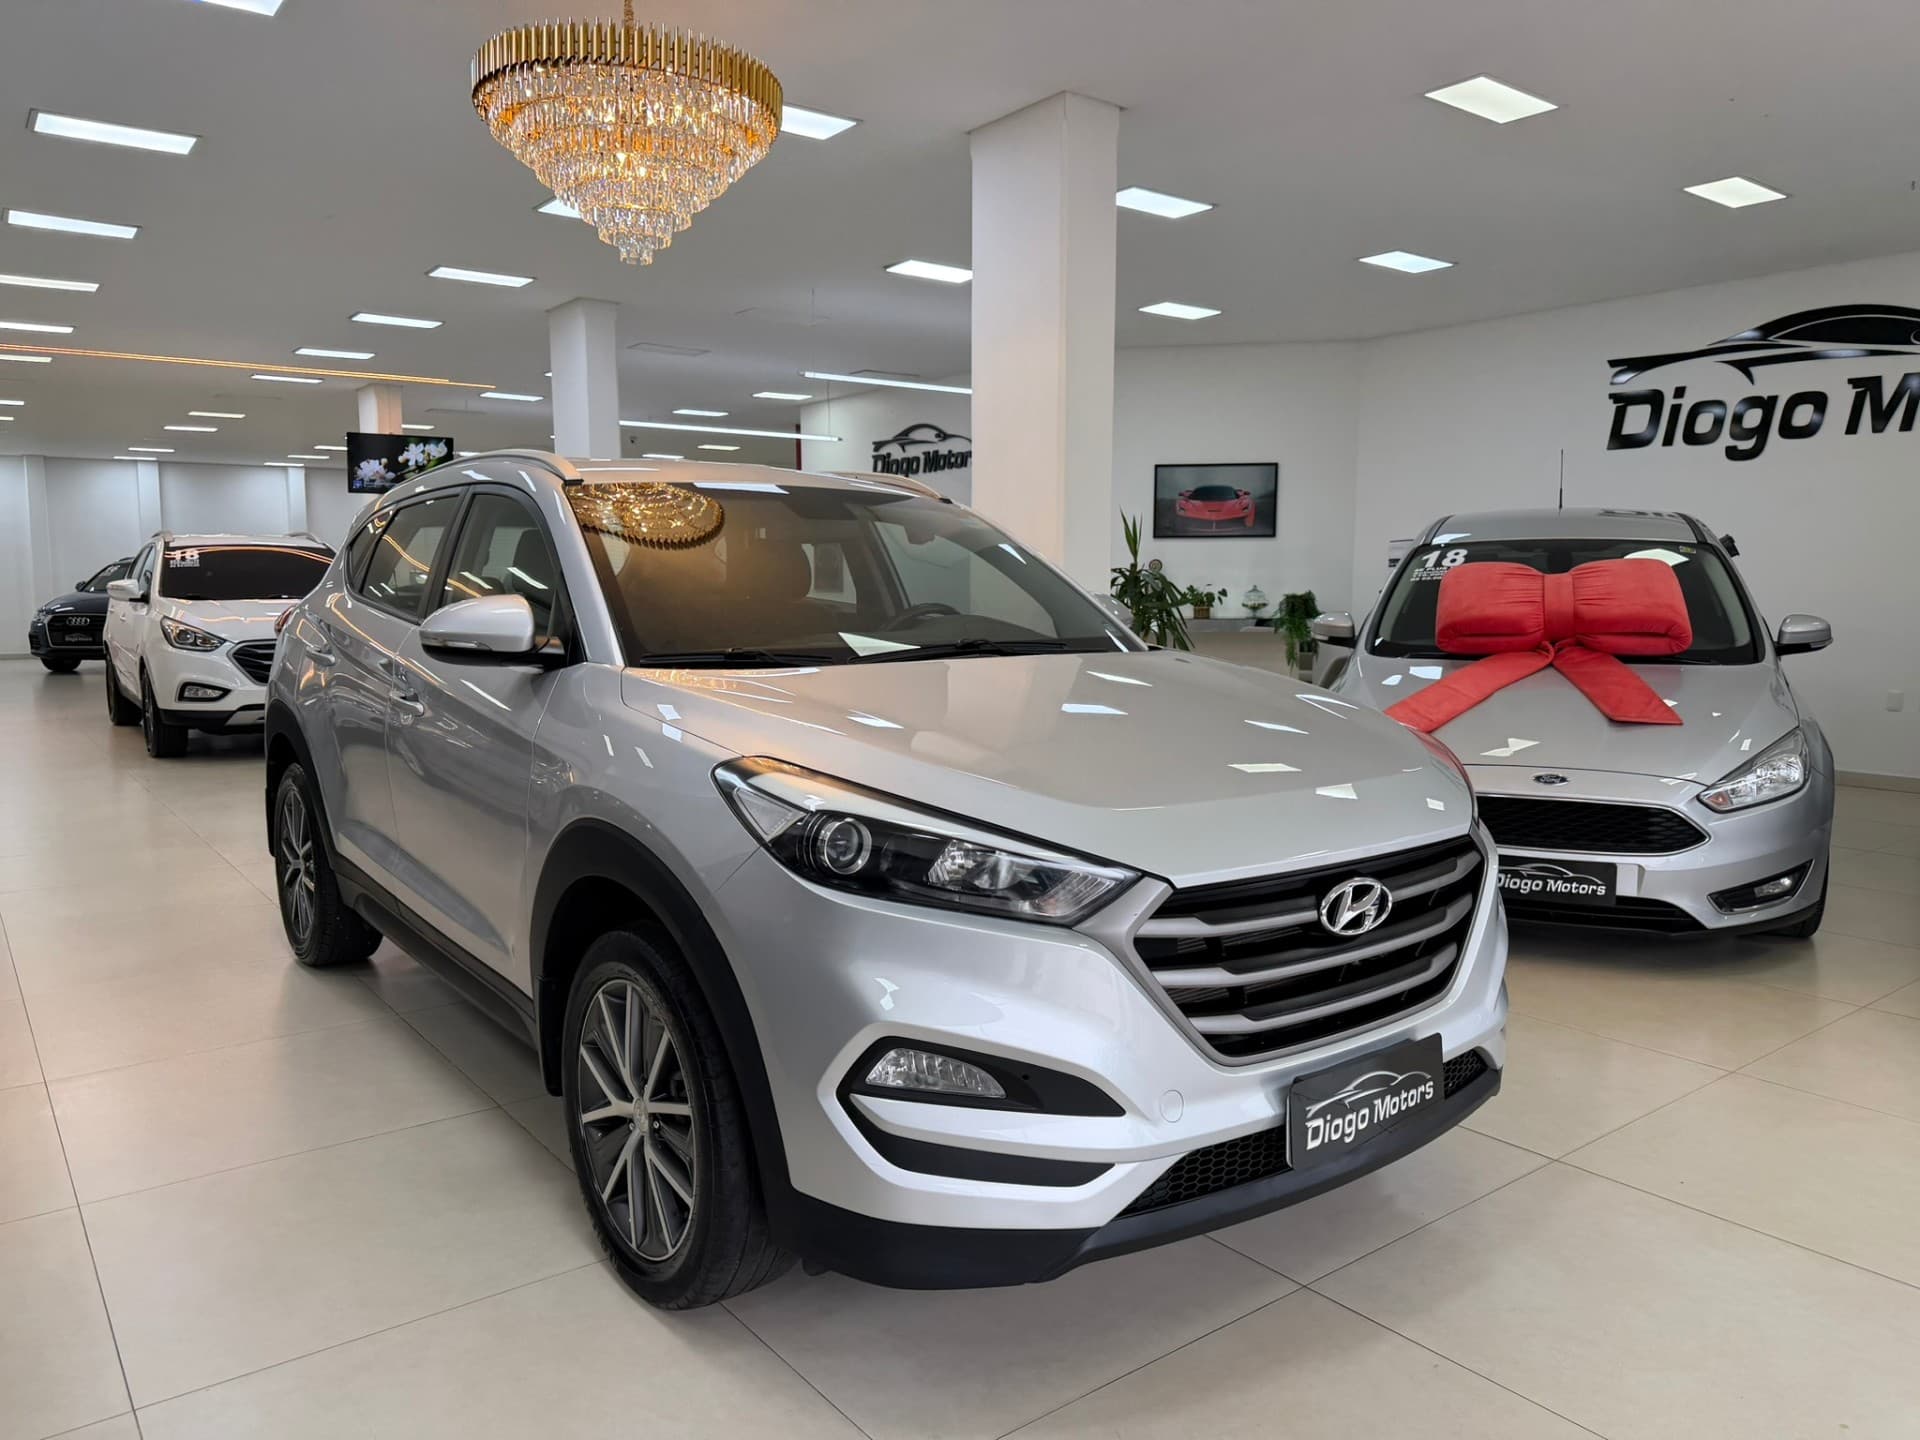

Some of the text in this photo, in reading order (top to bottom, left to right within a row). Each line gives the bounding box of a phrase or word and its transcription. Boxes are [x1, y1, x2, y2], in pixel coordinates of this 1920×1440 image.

[1607, 386, 1829, 462] Diogo
[872, 452, 920, 477] Diogo
[1421, 549, 1468, 568] 18
[1546, 879, 1606, 896] Motors
[1305, 1080, 1434, 1150] Diogo Motors
